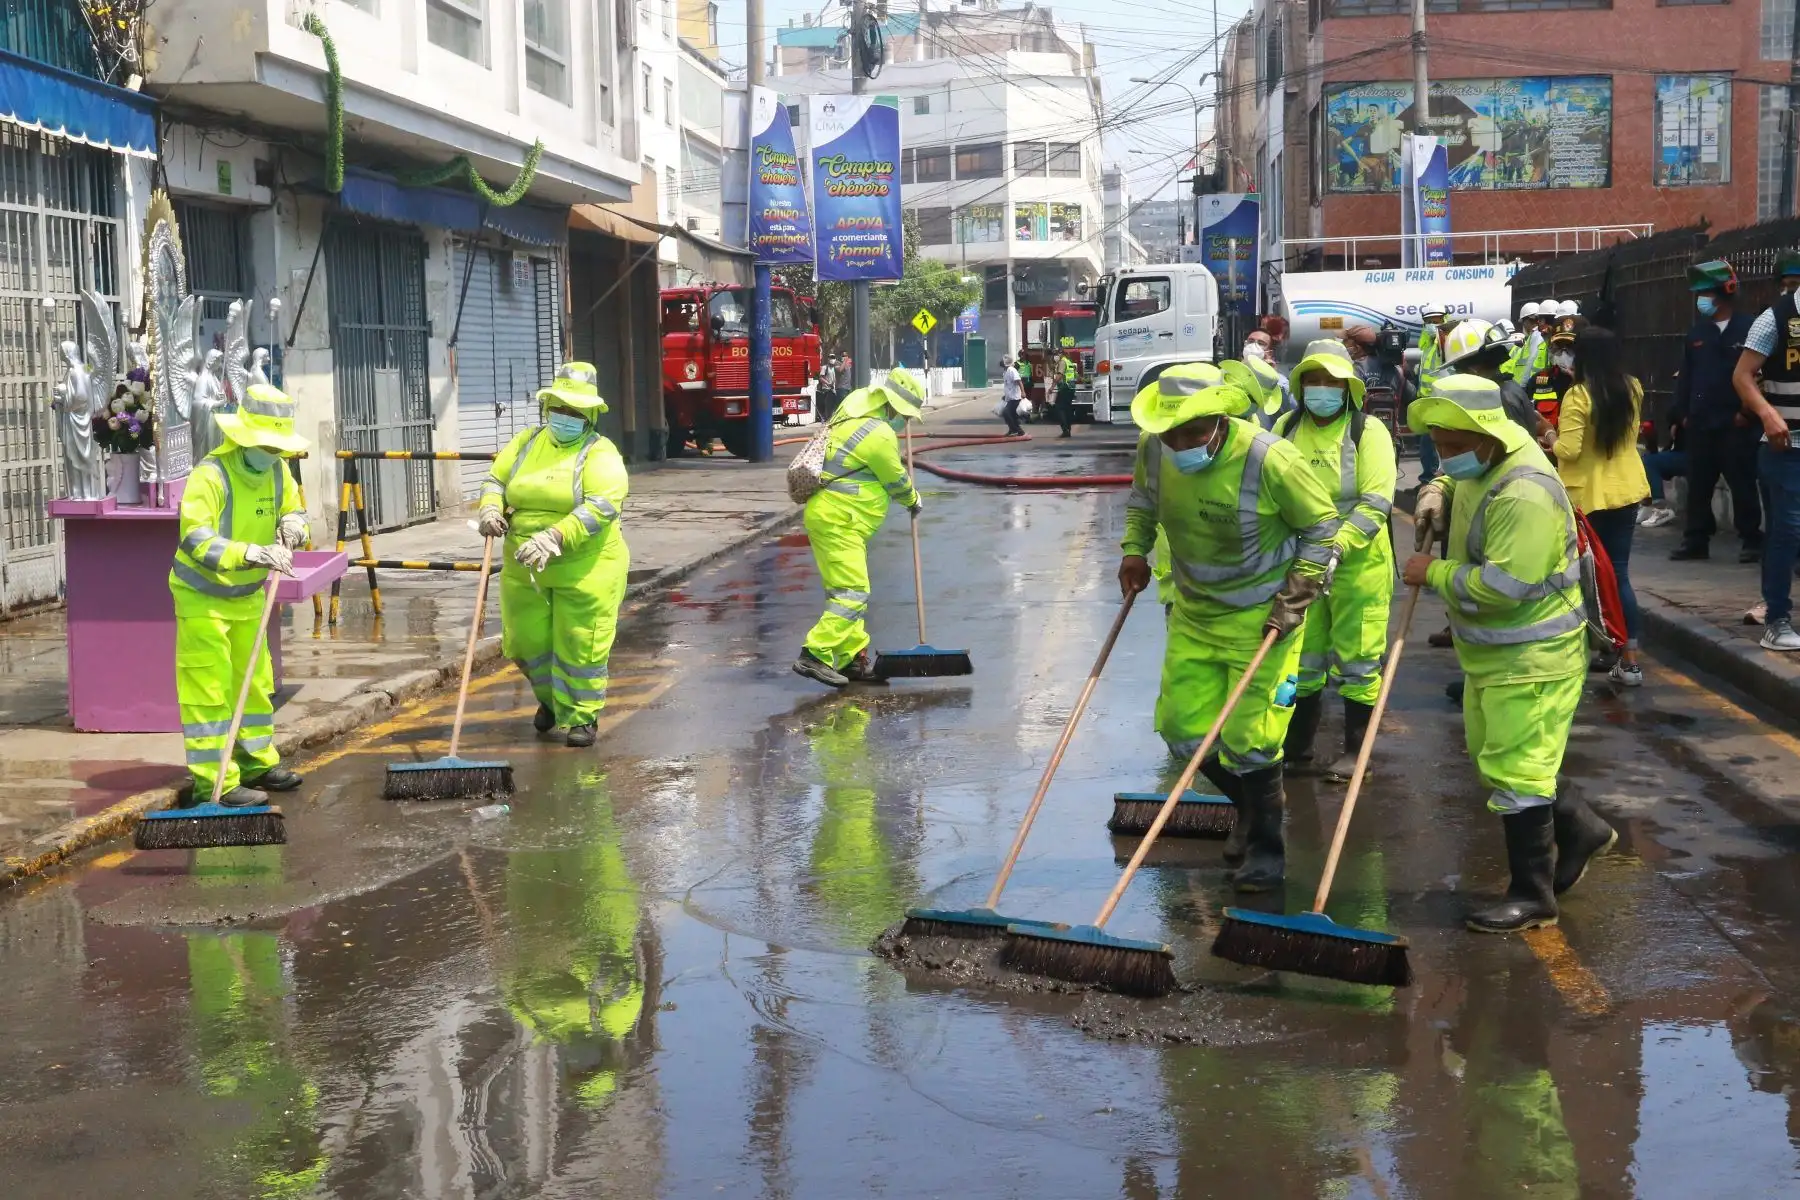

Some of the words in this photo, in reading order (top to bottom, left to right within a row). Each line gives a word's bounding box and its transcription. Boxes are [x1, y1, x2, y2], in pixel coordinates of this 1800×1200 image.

[815, 122, 844, 131] LIMA
[756, 144, 797, 170] Compra
[818, 153, 894, 178] Compra
[827, 180, 889, 197] chévere
[835, 216, 884, 231] APOYA
[838, 232, 888, 241] comerciante
[835, 242, 885, 261] formal
[1365, 272, 1395, 283] AGUA
[1405, 270, 1434, 282] PARA
[1445, 268, 1494, 281] CONSUMO
[1118, 326, 1150, 335] sedapal
[731, 346, 793, 357] BOROS
